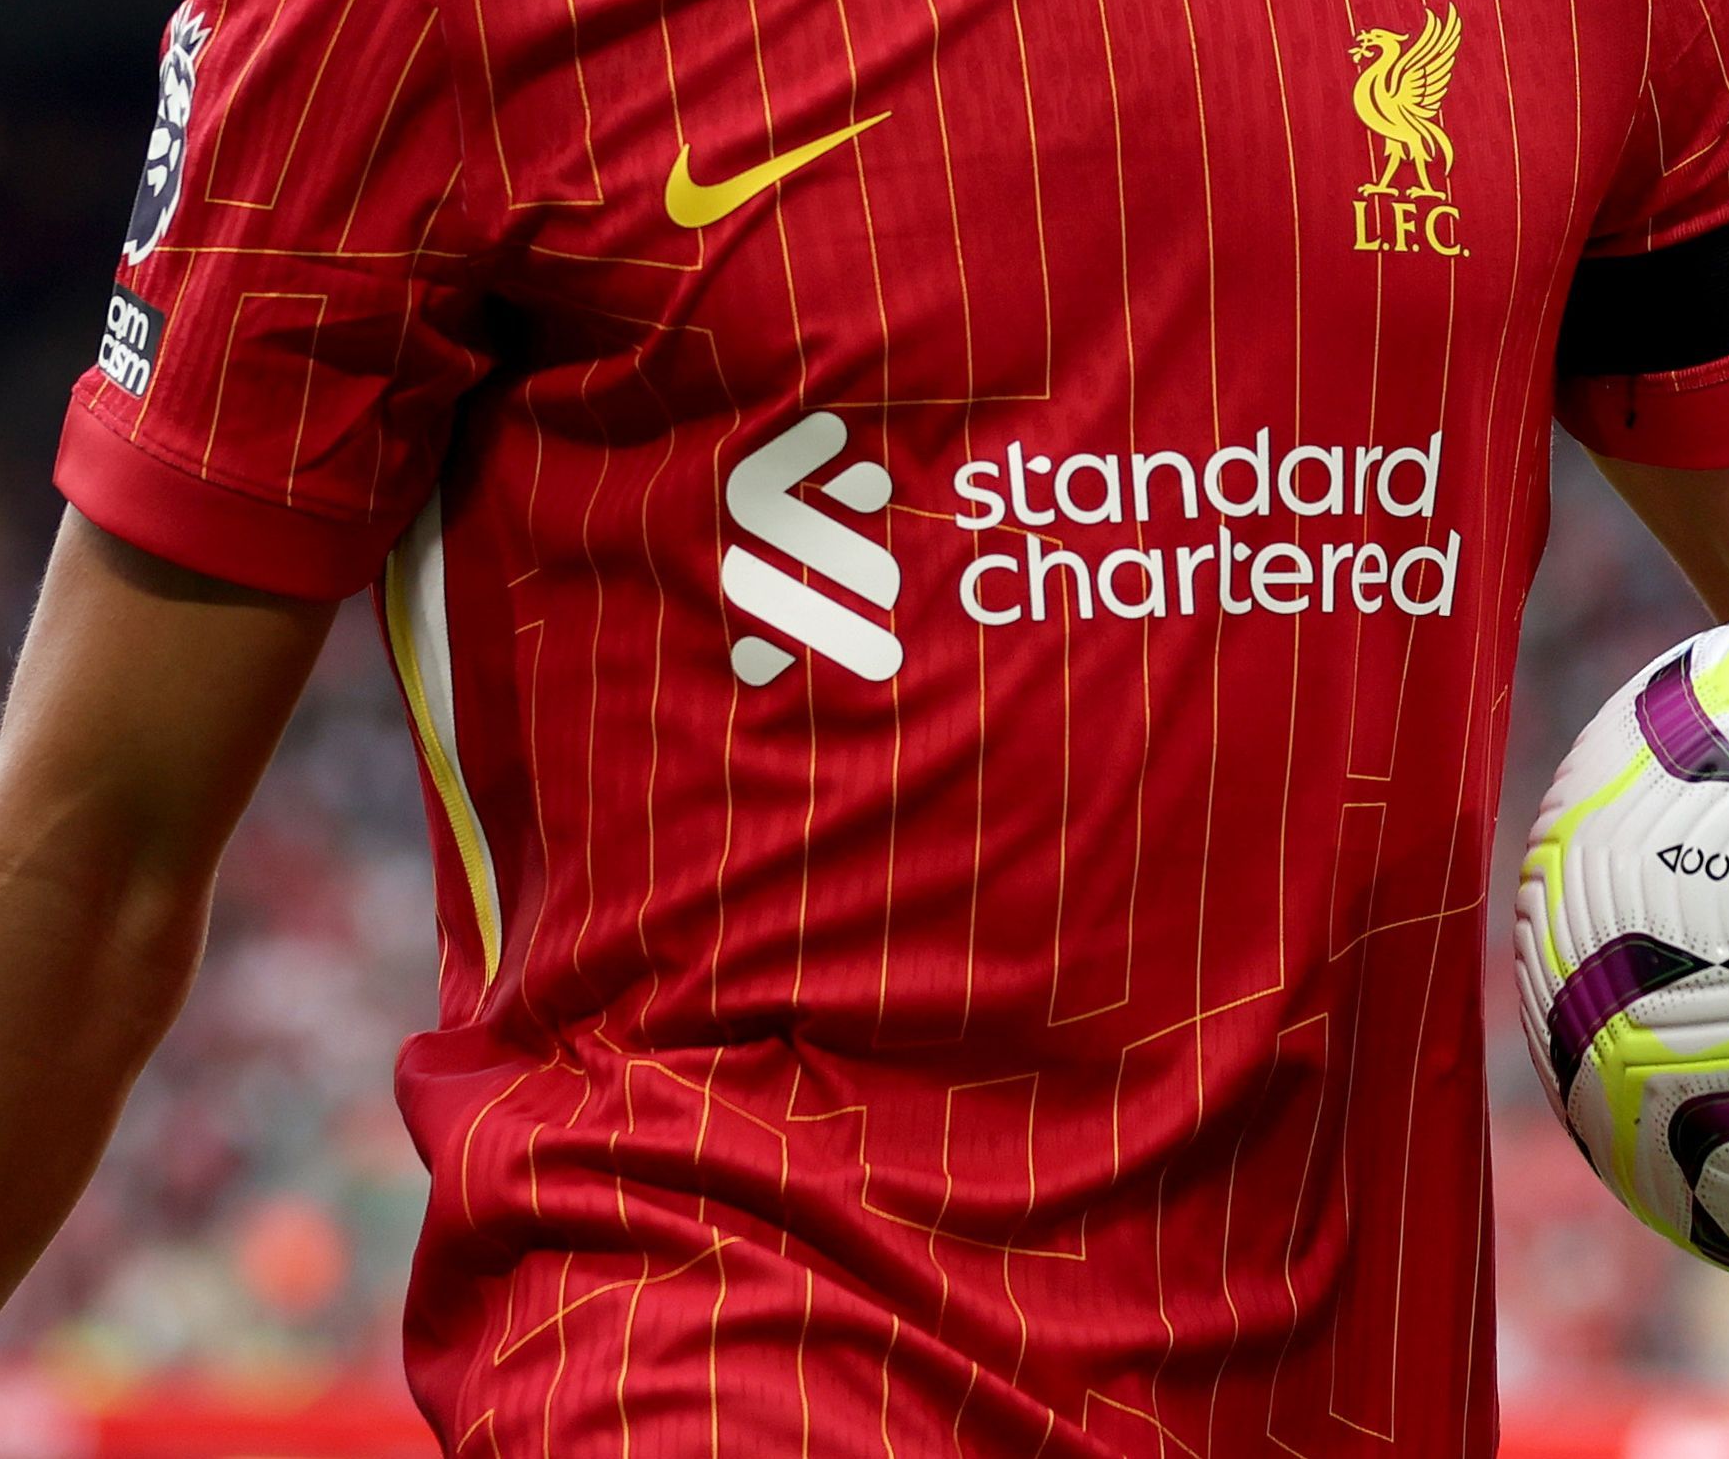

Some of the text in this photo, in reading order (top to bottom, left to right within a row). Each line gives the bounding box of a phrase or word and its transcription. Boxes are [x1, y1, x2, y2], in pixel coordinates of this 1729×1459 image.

[1353, 200, 1470, 258] L.F.C.
[954, 426, 1444, 531] standard
[958, 524, 1462, 626] chartered
